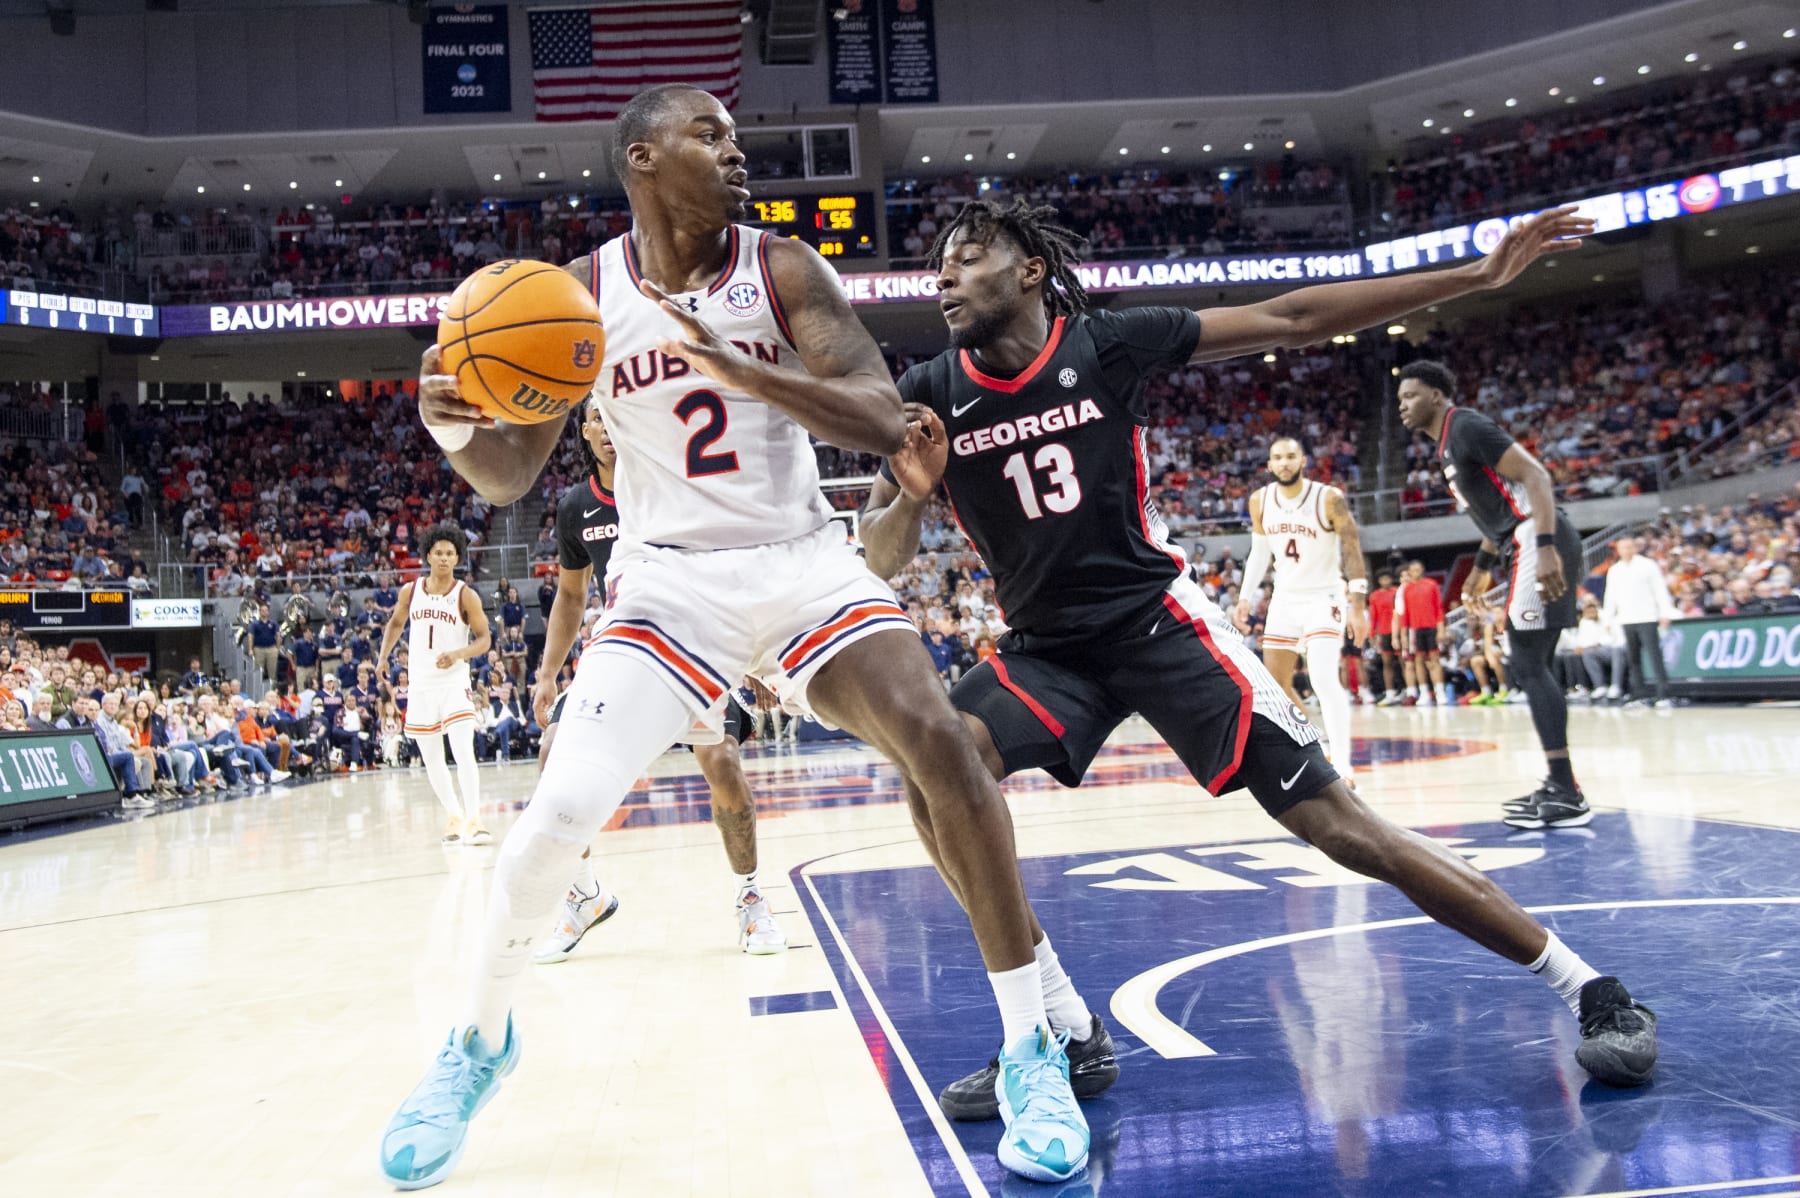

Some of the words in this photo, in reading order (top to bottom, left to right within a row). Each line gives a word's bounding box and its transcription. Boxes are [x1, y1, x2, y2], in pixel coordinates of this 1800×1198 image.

[436, 14, 494, 24] GYMNASTICS
[427, 44, 465, 56] FINAL
[468, 43, 504, 56] FOUR
[451, 85, 484, 97] 2022
[754, 201, 796, 222] 7:36
[874, 274, 939, 299] KING
[1104, 261, 1226, 287] ALABAMA
[1227, 257, 1303, 282] SINCE
[210, 296, 451, 332] BAUMHOWER'S
[612, 339, 779, 398] AUBN
[672, 388, 740, 478] 2
[953, 398, 1104, 456] GEORGIA
[1003, 443, 1082, 520] 13
[1266, 523, 1317, 539] AUBURN
[1285, 538, 1300, 563] 4
[154, 606, 200, 615] COOK'S
[411, 609, 457, 625] AUBURN
[428, 624, 434, 649] 1
[1695, 627, 1757, 670] OLD
[8, 746, 69, 790] LINE
